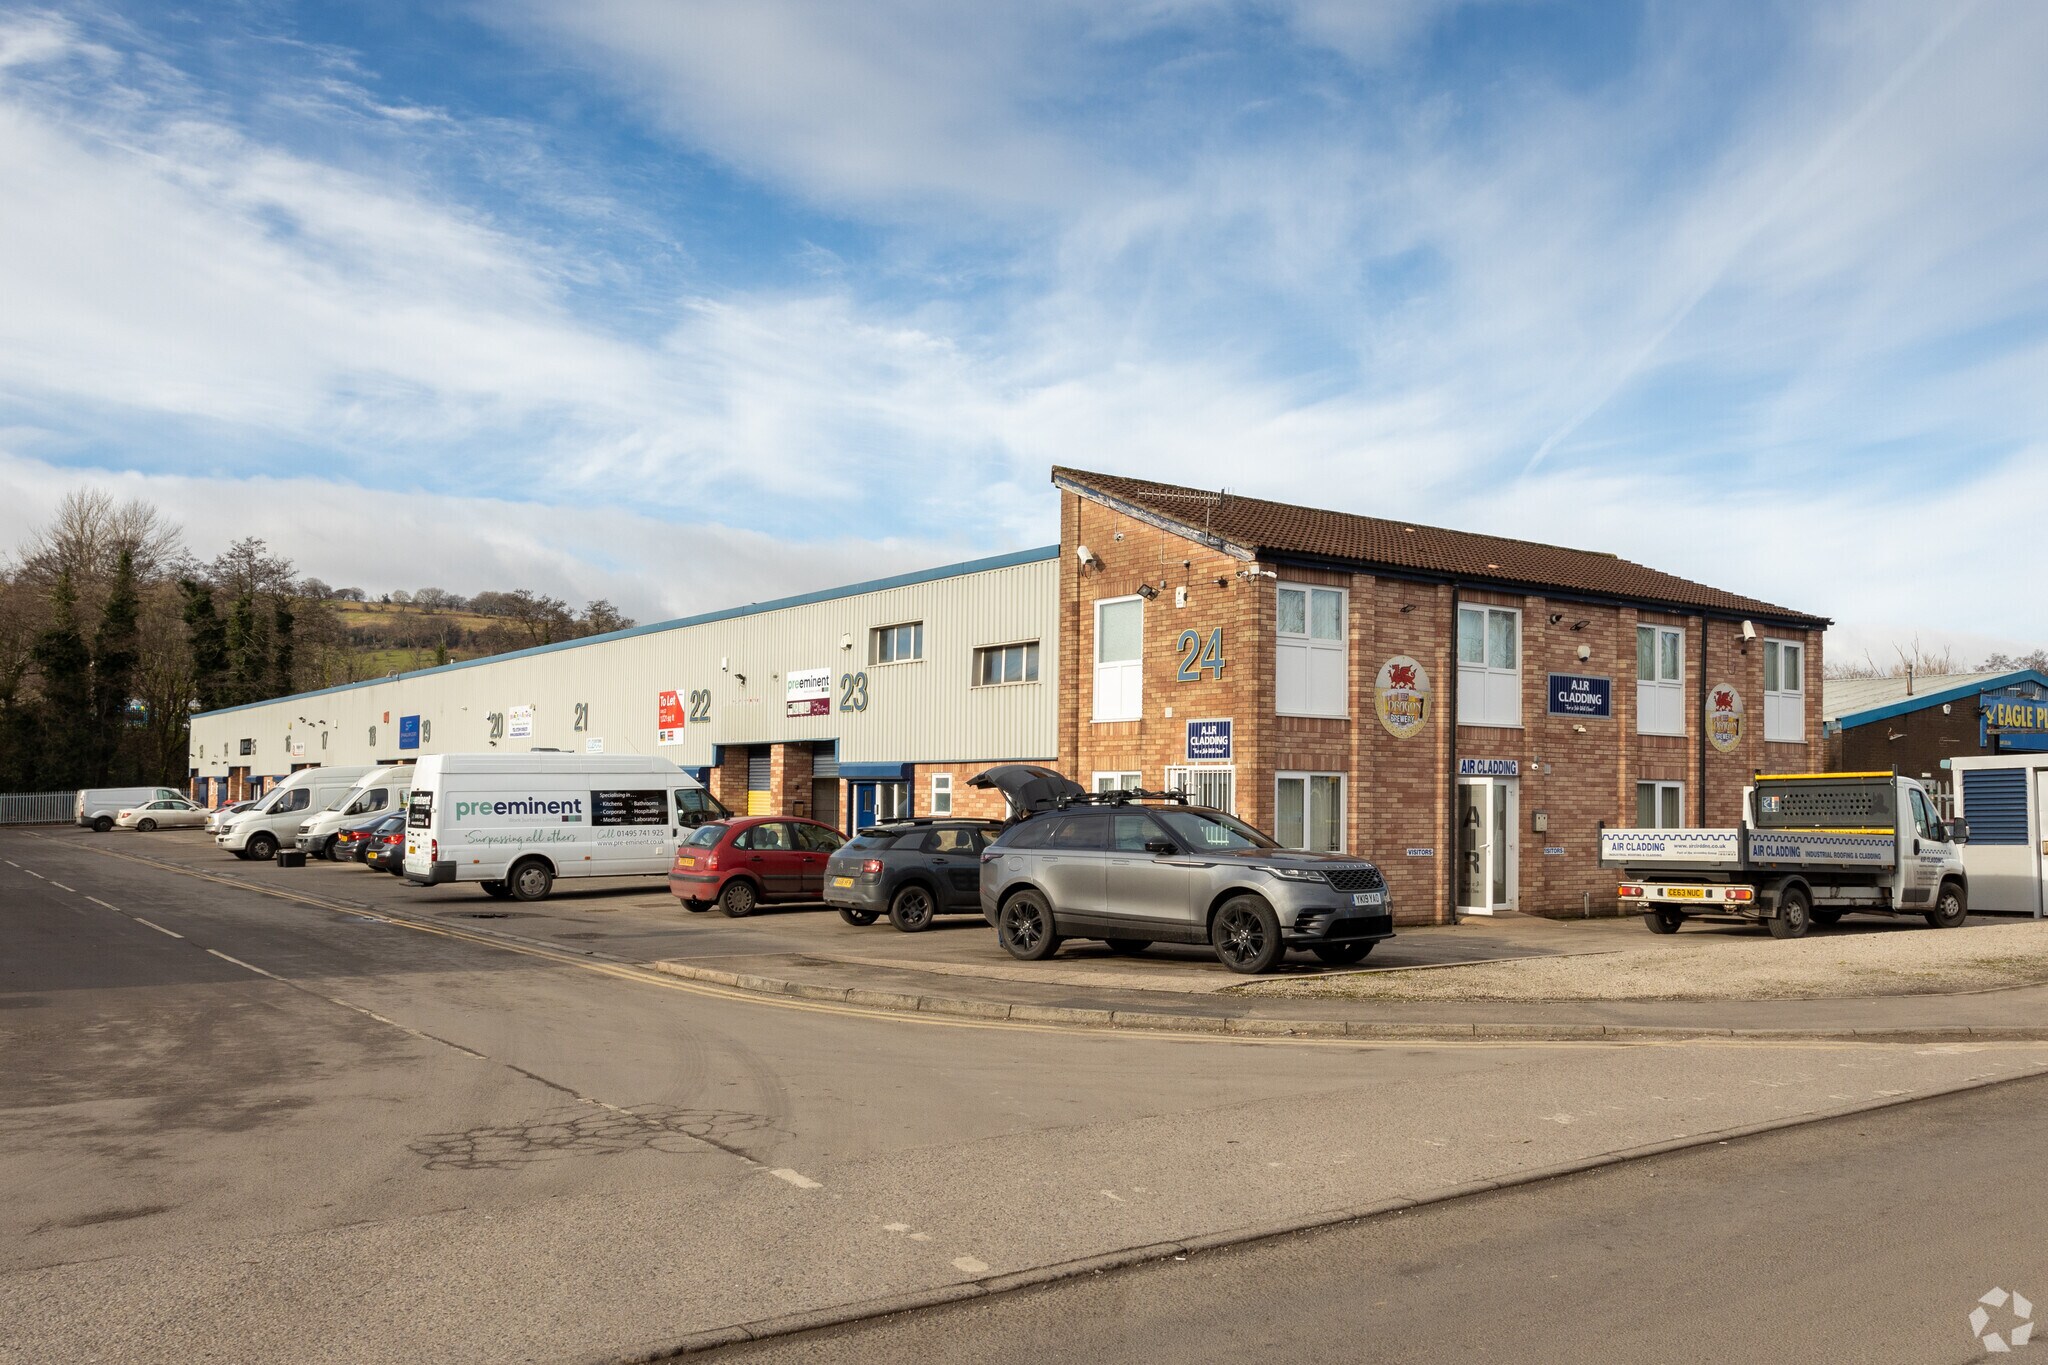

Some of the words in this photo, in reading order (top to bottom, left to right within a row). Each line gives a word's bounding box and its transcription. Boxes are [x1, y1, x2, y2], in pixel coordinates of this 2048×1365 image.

[1176, 627, 1226, 682] 24
[788, 675, 829, 693] preeminent
[840, 672, 868, 712] 23
[660, 696, 666, 706] To
[667, 695, 676, 706] Let
[690, 689, 711, 722] 22
[1388, 701, 1422, 713] DRAGON
[1558, 691, 1602, 705] CLADDING
[574, 703, 588, 732] 21
[1391, 714, 1415, 724] BREWERY
[1997, 704, 2033, 728] EAGLE
[421, 720, 431, 743] 19
[490, 713, 504, 739] 20
[321, 731, 328, 750] 17
[368, 725, 377, 747] 18
[1190, 736, 1228, 746] CLADDING
[1461, 759, 1475, 774] AIR
[1477, 760, 1517, 775] CLADDING
[456, 797, 582, 821] preeminent
[468, 830, 523, 850] Surpassing
[526, 829, 544, 842] all
[547, 828, 577, 843] others
[597, 829, 616, 840] Call
[616, 829, 637, 837] 01495
[597, 839, 664, 847] www.pre-eminent.co.uk
[1611, 842, 1624, 851] AIR
[1626, 842, 1665, 851] CLADDING
[1753, 845, 1764, 856] AIR
[1766, 845, 1801, 858] CLADDING
[1668, 888, 1686, 896] CE63
[1687, 889, 1700, 897] NUC
